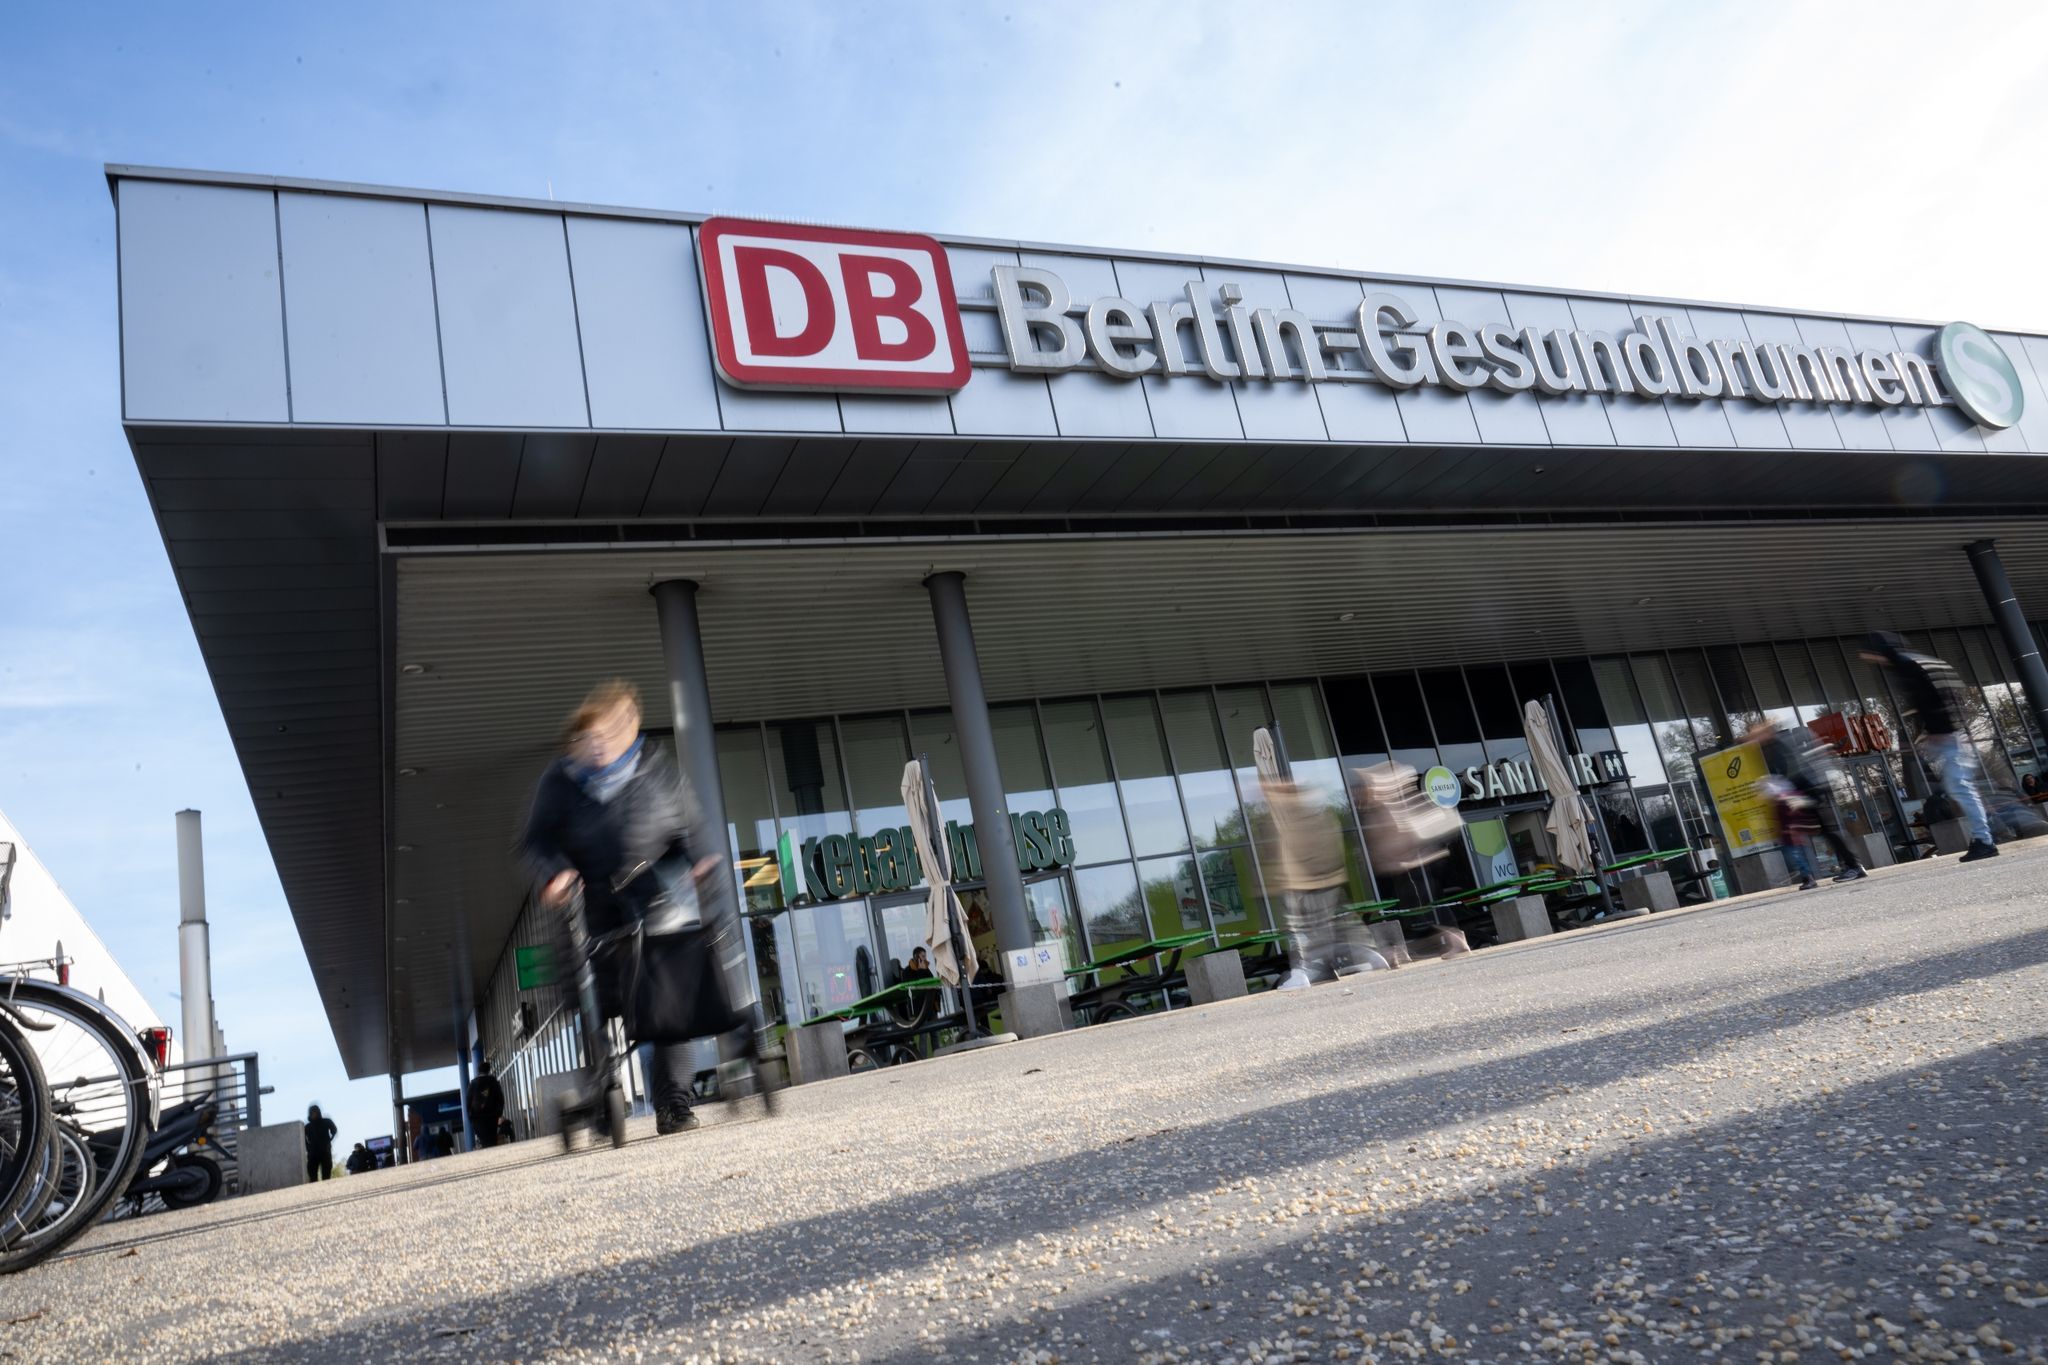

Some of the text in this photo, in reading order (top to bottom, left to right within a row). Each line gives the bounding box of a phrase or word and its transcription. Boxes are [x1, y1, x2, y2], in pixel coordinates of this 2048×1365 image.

[733, 244, 937, 362] DB
[991, 264, 1943, 407] Berlin-Gesundbrunnen
[1951, 332, 2014, 415] S
[1465, 753, 1600, 800] SANIIR
[946, 807, 1076, 880] hse
[1494, 862, 1516, 878] WC
